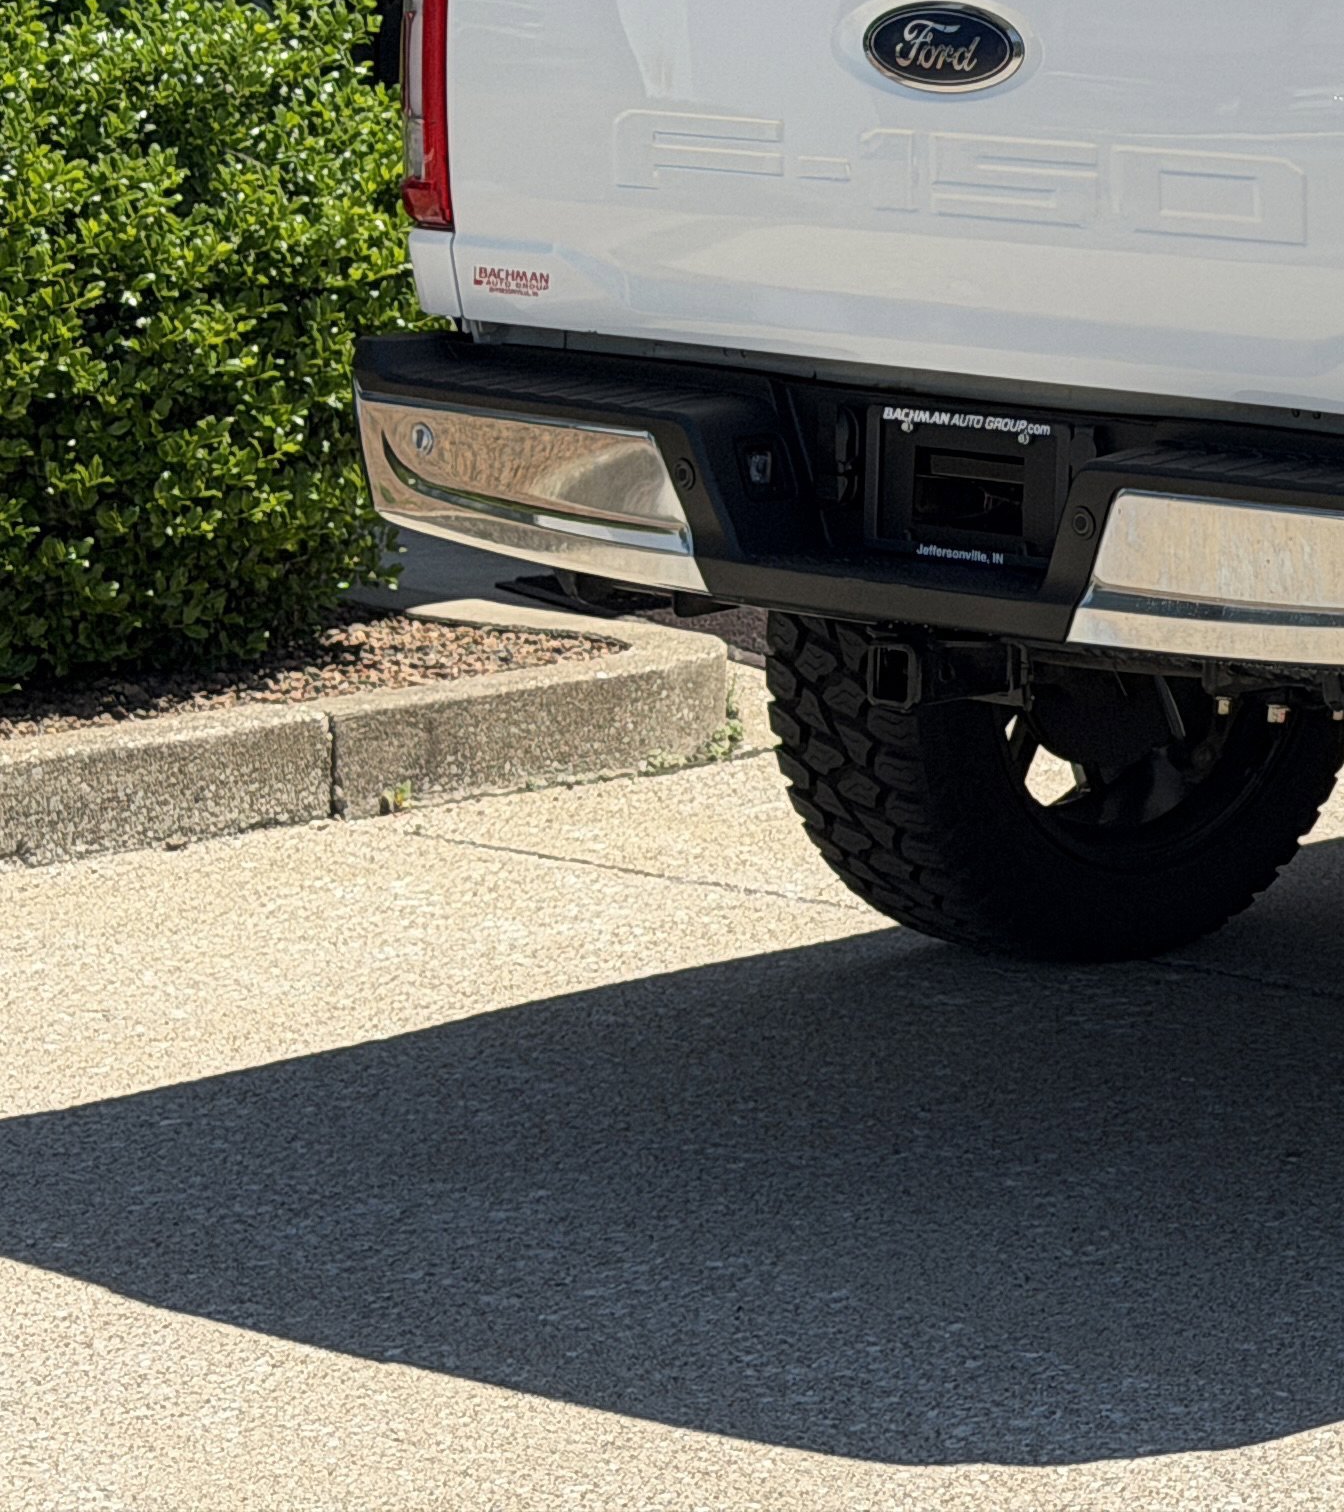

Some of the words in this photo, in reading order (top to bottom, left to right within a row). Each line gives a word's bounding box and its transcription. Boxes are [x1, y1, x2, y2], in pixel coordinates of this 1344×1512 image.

[896, 19, 981, 72] Ford
[613, 109, 1307, 246] F-150
[479, 266, 550, 285] BACHMAN
[485, 278, 512, 288] AUTO
[883, 406, 950, 425] BACHMAN
[950, 414, 984, 429] AUTO
[916, 543, 990, 564] Jeffersonville,
[992, 553, 1004, 565] IN
